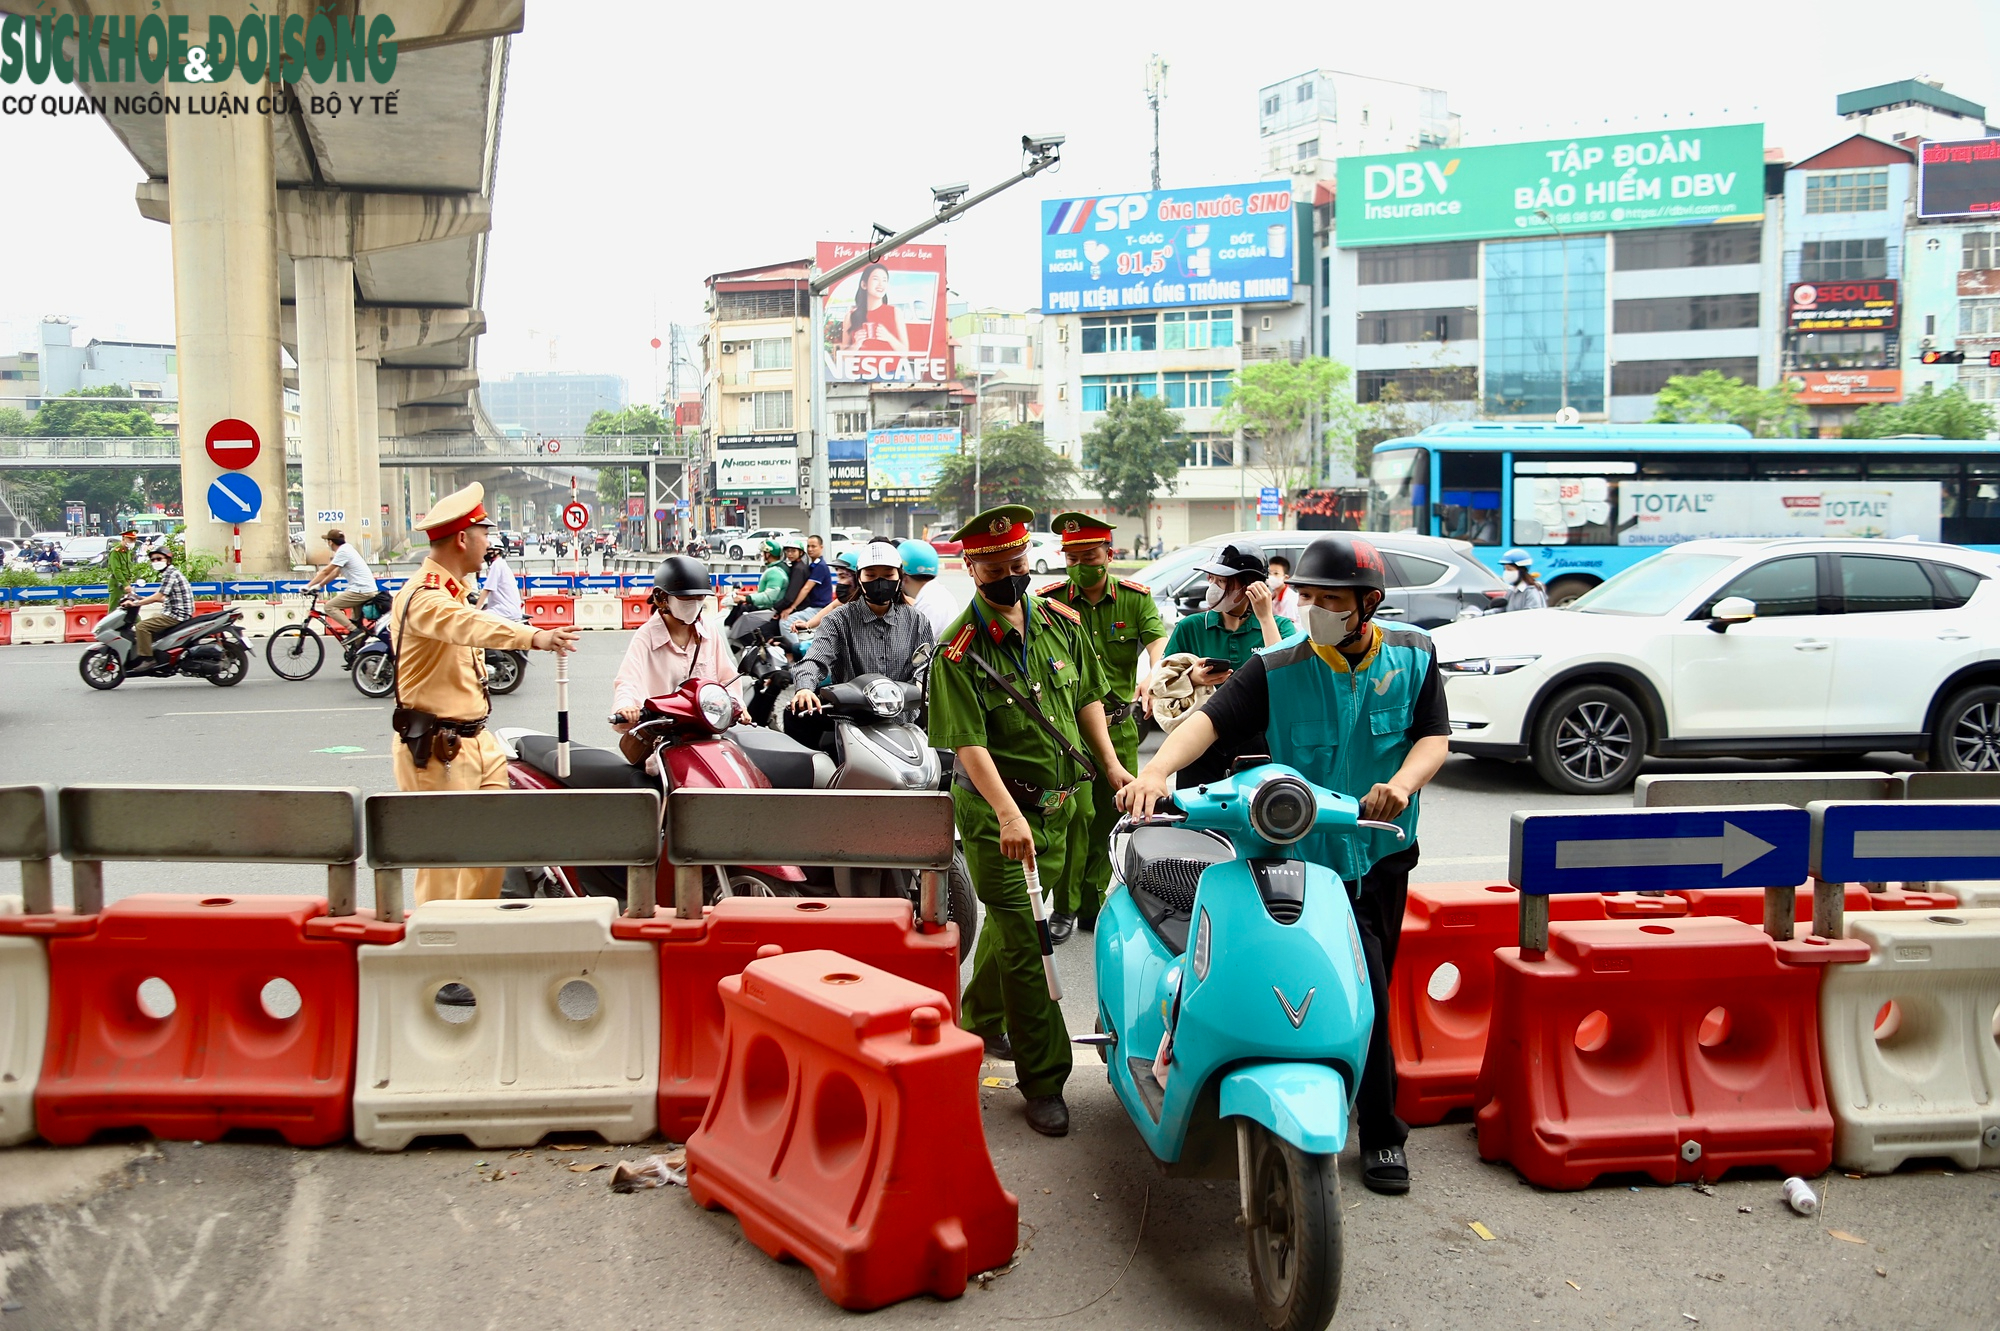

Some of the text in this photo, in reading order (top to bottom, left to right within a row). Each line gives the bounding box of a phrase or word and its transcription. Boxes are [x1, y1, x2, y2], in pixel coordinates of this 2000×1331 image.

[1546, 135, 1702, 177] TẬP ĐOÀN
[1364, 159, 1461, 200] DBV
[1514, 167, 1737, 210] BẢO HIỂM DBV
[1095, 195, 1149, 232] SP
[1158, 192, 1291, 221] ỐNG NƯỚC SINO
[1055, 249, 1078, 260] REN
[1218, 249, 1237, 260] CO
[1049, 259, 1084, 273] NGOÀI
[1049, 277, 1289, 311] PHỤ KIỆN NỐI ỐNG THÔNG MINH
[1816, 285, 1885, 302] SEOUL
[874, 432, 955, 445] GẤU BÔNG MAI ANH
[838, 467, 865, 478] MOBILE
[318, 511, 344, 522] P239
[1261, 869, 1300, 877] VINFAST
